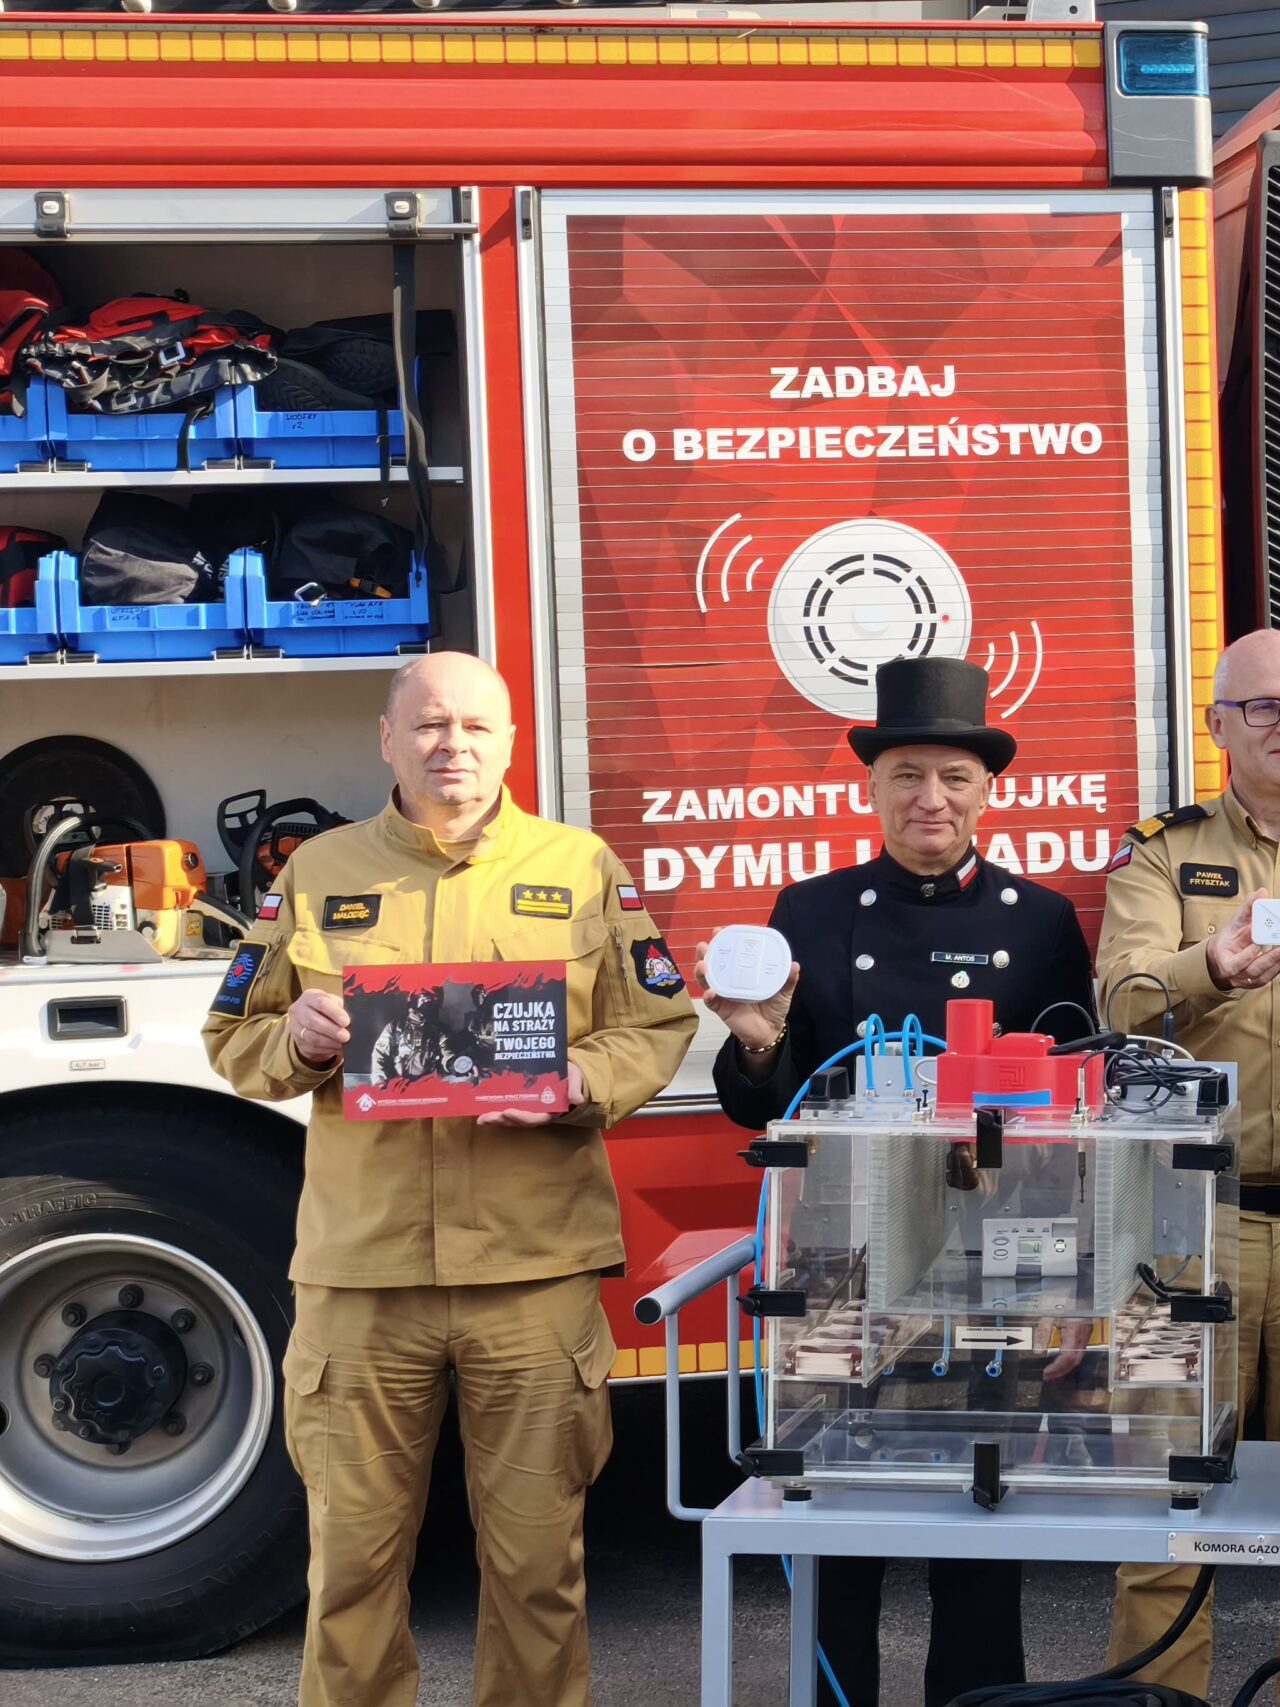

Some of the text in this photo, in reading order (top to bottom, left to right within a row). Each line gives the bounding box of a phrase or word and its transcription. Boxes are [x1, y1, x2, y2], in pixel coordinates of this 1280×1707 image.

[769, 365, 957, 399] ZADBAJ
[622, 417, 1103, 462] O BEZPIECZEŃSTWO
[642, 774, 1107, 823] ZAMONTU UJKĘ
[643, 841, 830, 892] DYMU
[985, 829, 1110, 875] ADU
[1190, 878, 1230, 887] FRYSZTAK
[1196, 871, 1223, 879] PAWEŁ
[493, 1001, 555, 1019] CZUJKA
[494, 1016, 555, 1032] NA STRAŻY
[495, 1036, 556, 1051] TWOJEGO
[495, 1050, 556, 1060] BEZPIECZEŃSTWA
[1194, 1541, 1245, 1554] KOMORA
